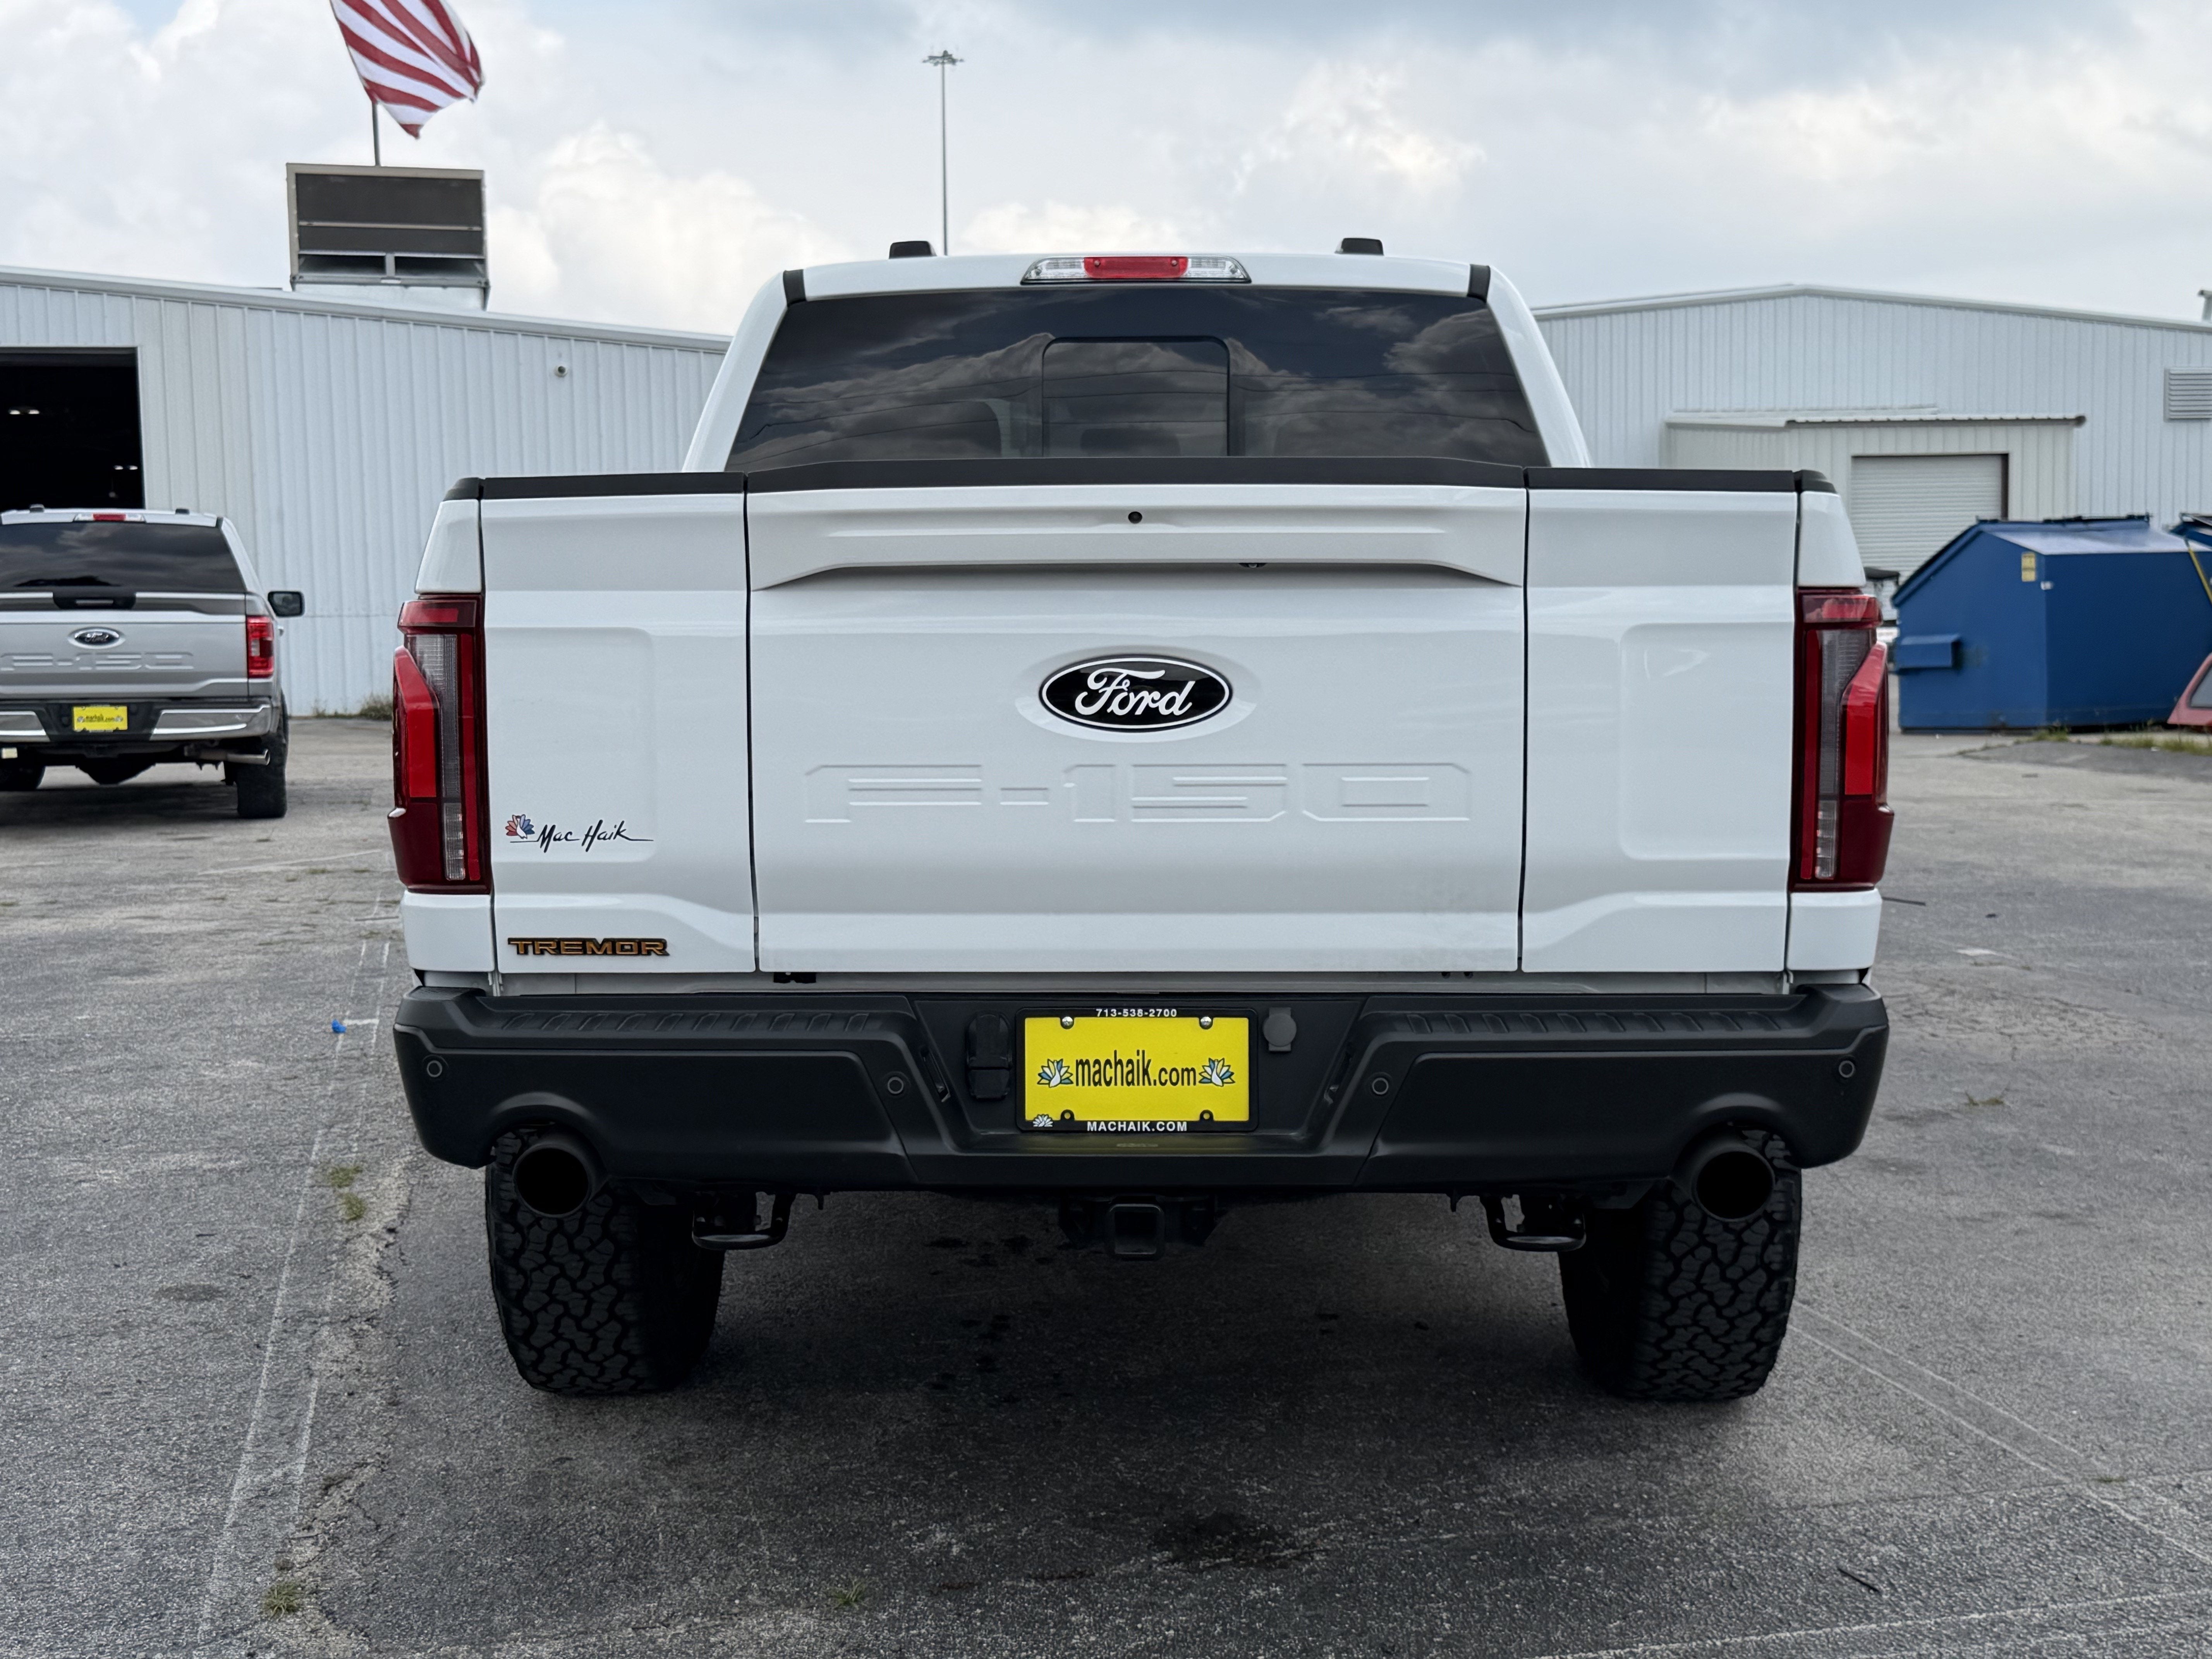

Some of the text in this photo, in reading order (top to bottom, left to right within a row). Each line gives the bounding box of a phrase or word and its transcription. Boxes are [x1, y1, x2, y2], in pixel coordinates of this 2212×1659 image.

[1075, 668, 1196, 716] Ford
[804, 762, 1470, 822] F-150
[511, 819, 654, 853] Mac Haik
[508, 938, 670, 956] TREMOR
[1096, 1008, 1177, 1017] 713-538-2700
[1075, 1050, 1196, 1086] machaik.com
[1087, 1121, 1187, 1132] MACHAIK.COM
